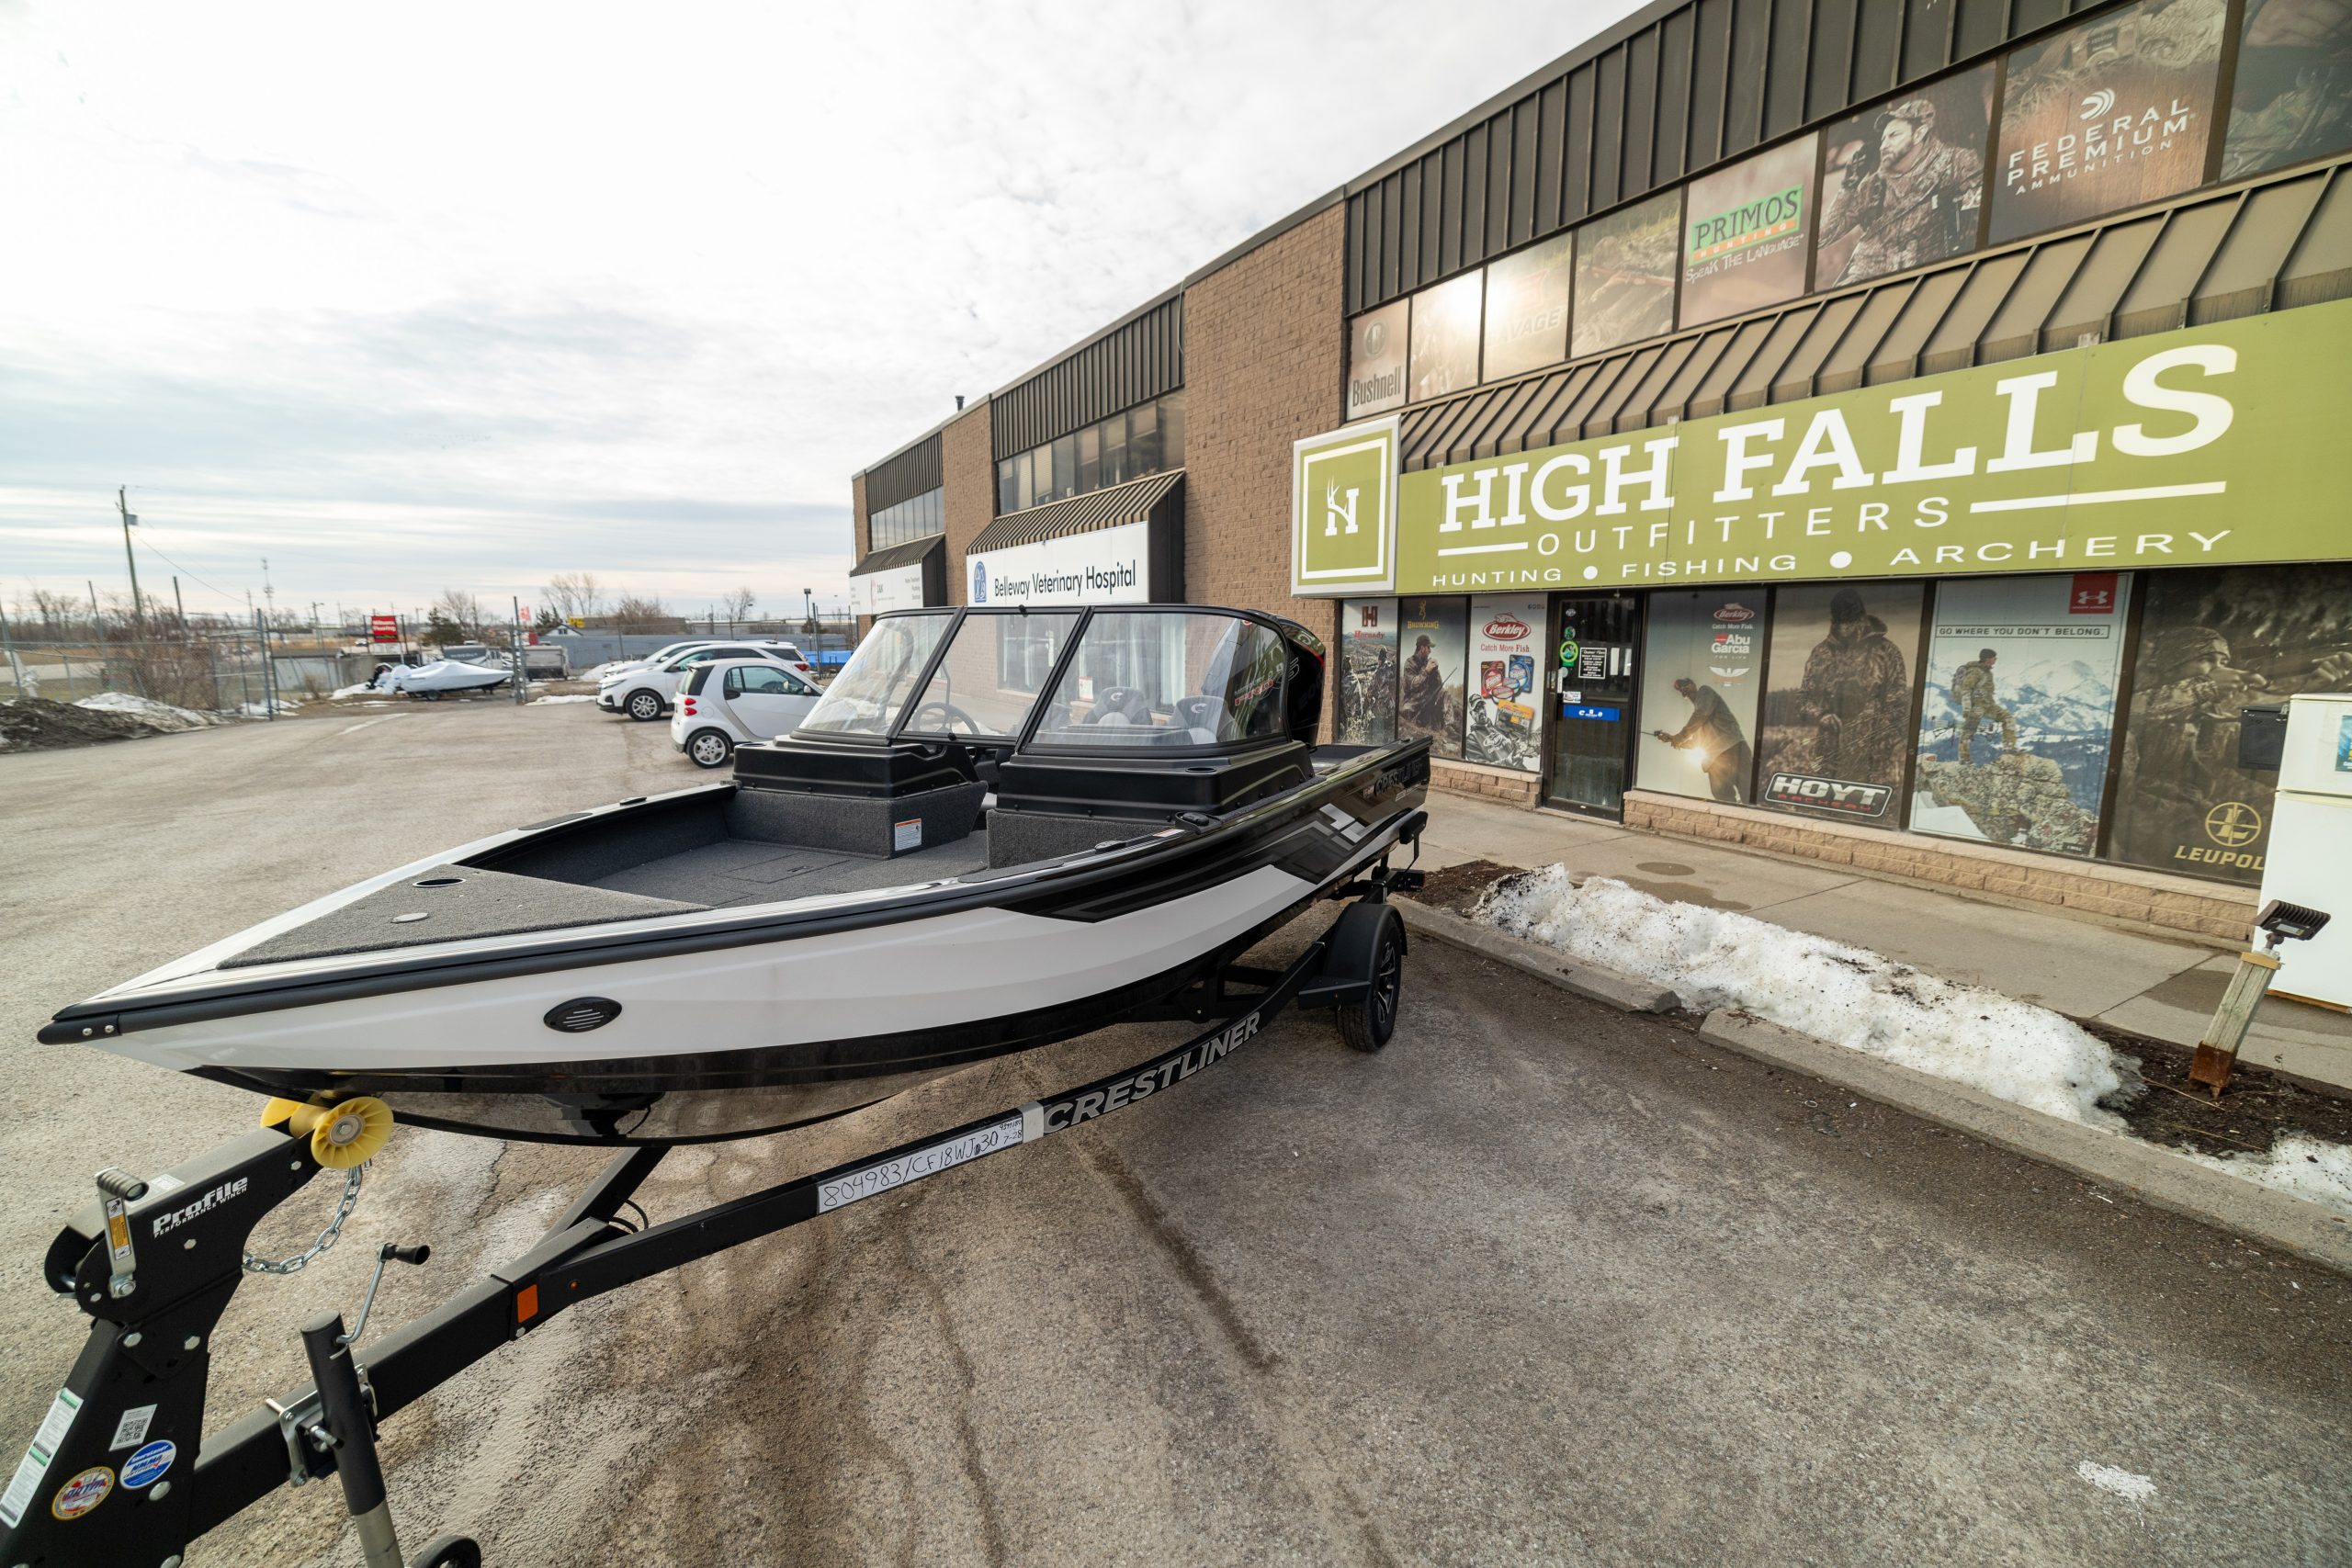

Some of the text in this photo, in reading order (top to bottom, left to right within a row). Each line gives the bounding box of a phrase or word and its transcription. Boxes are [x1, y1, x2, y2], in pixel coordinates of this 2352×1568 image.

[2007, 115, 2188, 186] PREMIUM
[2008, 98, 2189, 169] FEDERAL
[2015, 139, 2173, 196] AMMUNITION
[1693, 189, 1800, 251] PRIMOS
[1352, 366, 1401, 407] Bushnell
[1439, 344, 2238, 533] HIGH FALLS
[1537, 497, 1951, 556] OUTFITTERS
[994, 559, 1136, 600] Belleway Veterinary Hospital
[1432, 529, 2233, 587] HUNTING FISHING ARCHERY
[1488, 624, 1524, 638] Berkley
[1719, 610, 1750, 620] Berkley
[1725, 634, 1751, 645] Abu
[1939, 627, 2105, 637] GO WHERE YOU DON'T BELONG.
[1480, 643, 1498, 652] Catch
[1499, 644, 1514, 652] More
[1711, 642, 1750, 654] Garcia
[1772, 776, 1886, 806] HOYT
[1042, 1010, 1261, 1134] CRESTLINER
[153, 1177, 248, 1235] Profile
[154, 1201, 217, 1239] PERFORMANCE
[220, 1186, 247, 1204] WINCH
